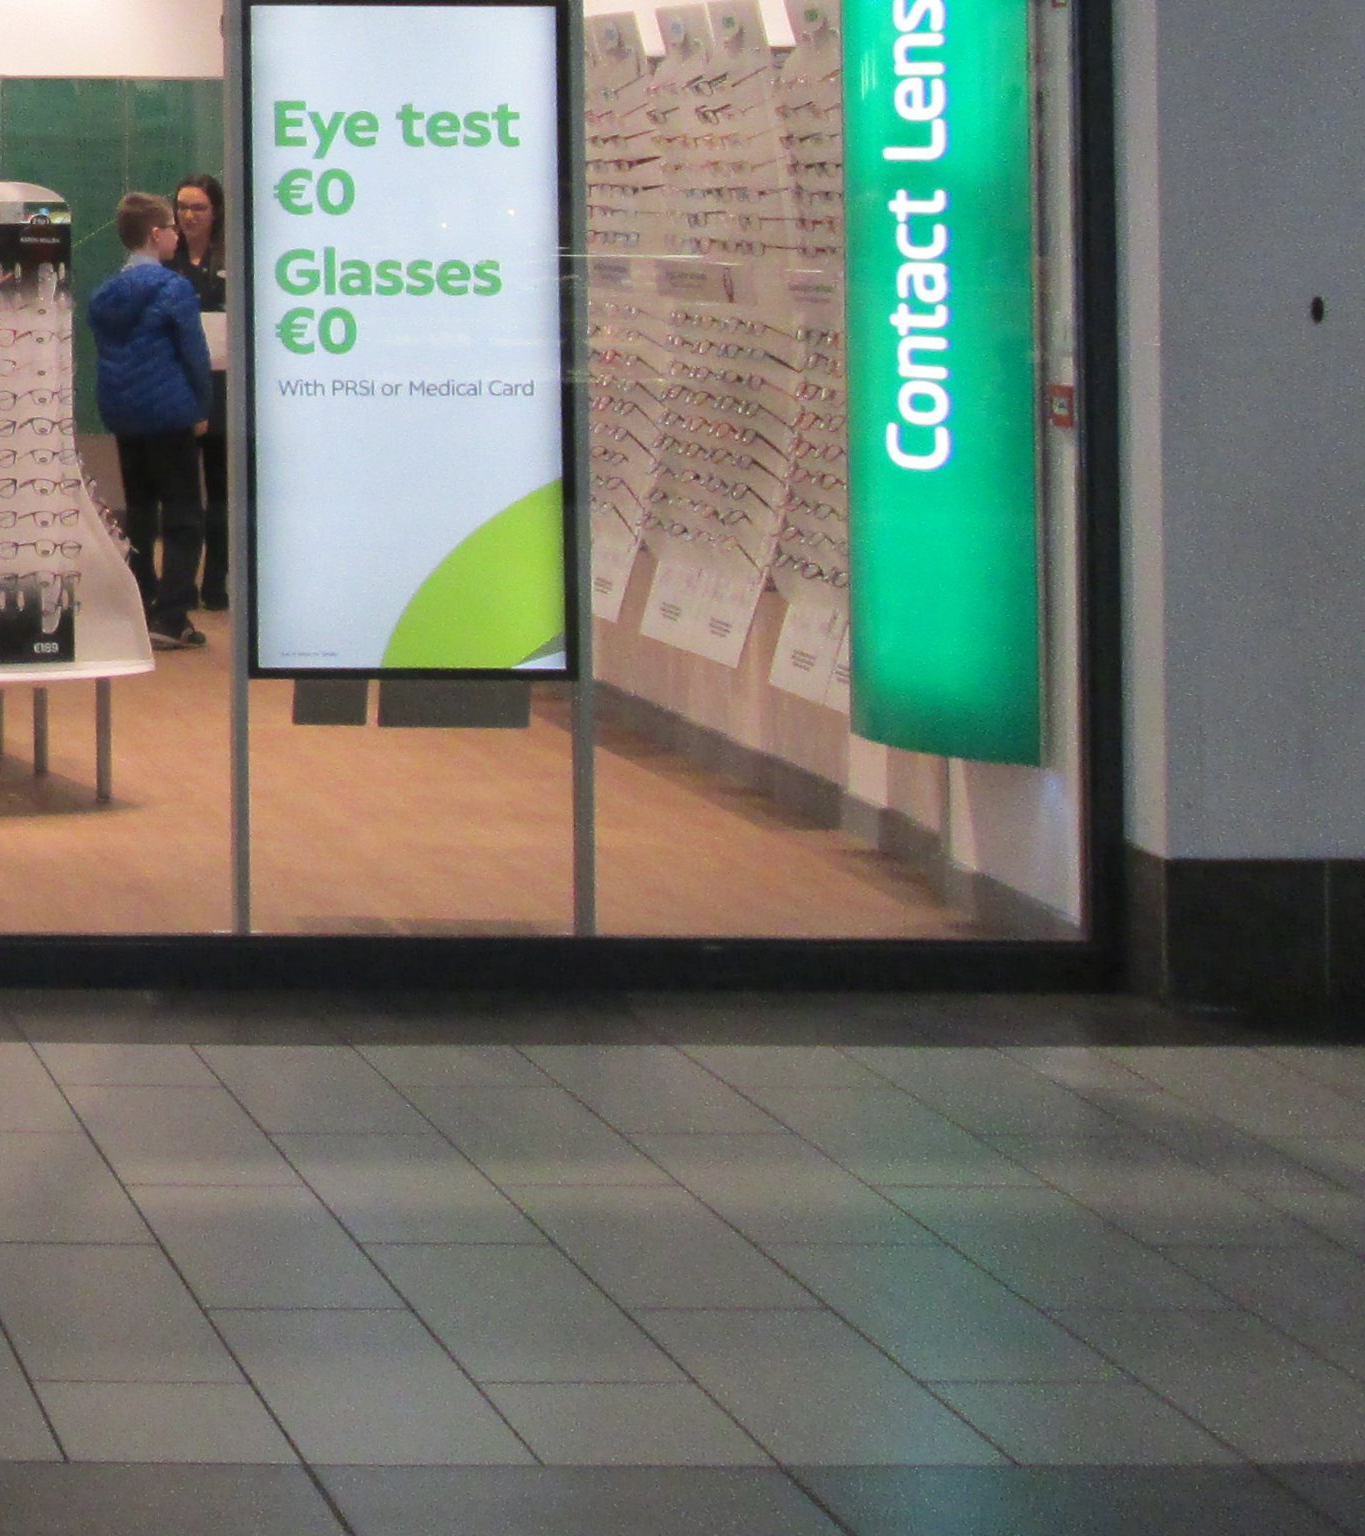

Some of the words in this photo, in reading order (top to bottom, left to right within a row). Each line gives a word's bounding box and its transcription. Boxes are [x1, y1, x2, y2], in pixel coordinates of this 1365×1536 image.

[273, 100, 379, 160] Eye
[395, 103, 521, 148] test
[273, 167, 356, 216] €0
[274, 246, 503, 297] Glasses
[275, 306, 358, 355] €0
[885, 189, 951, 471] Contact
[278, 379, 325, 397] With
[332, 380, 375, 397] PRSI
[381, 383, 403, 397] or
[409, 379, 482, 397] Medical
[487, 379, 535, 397] Card
